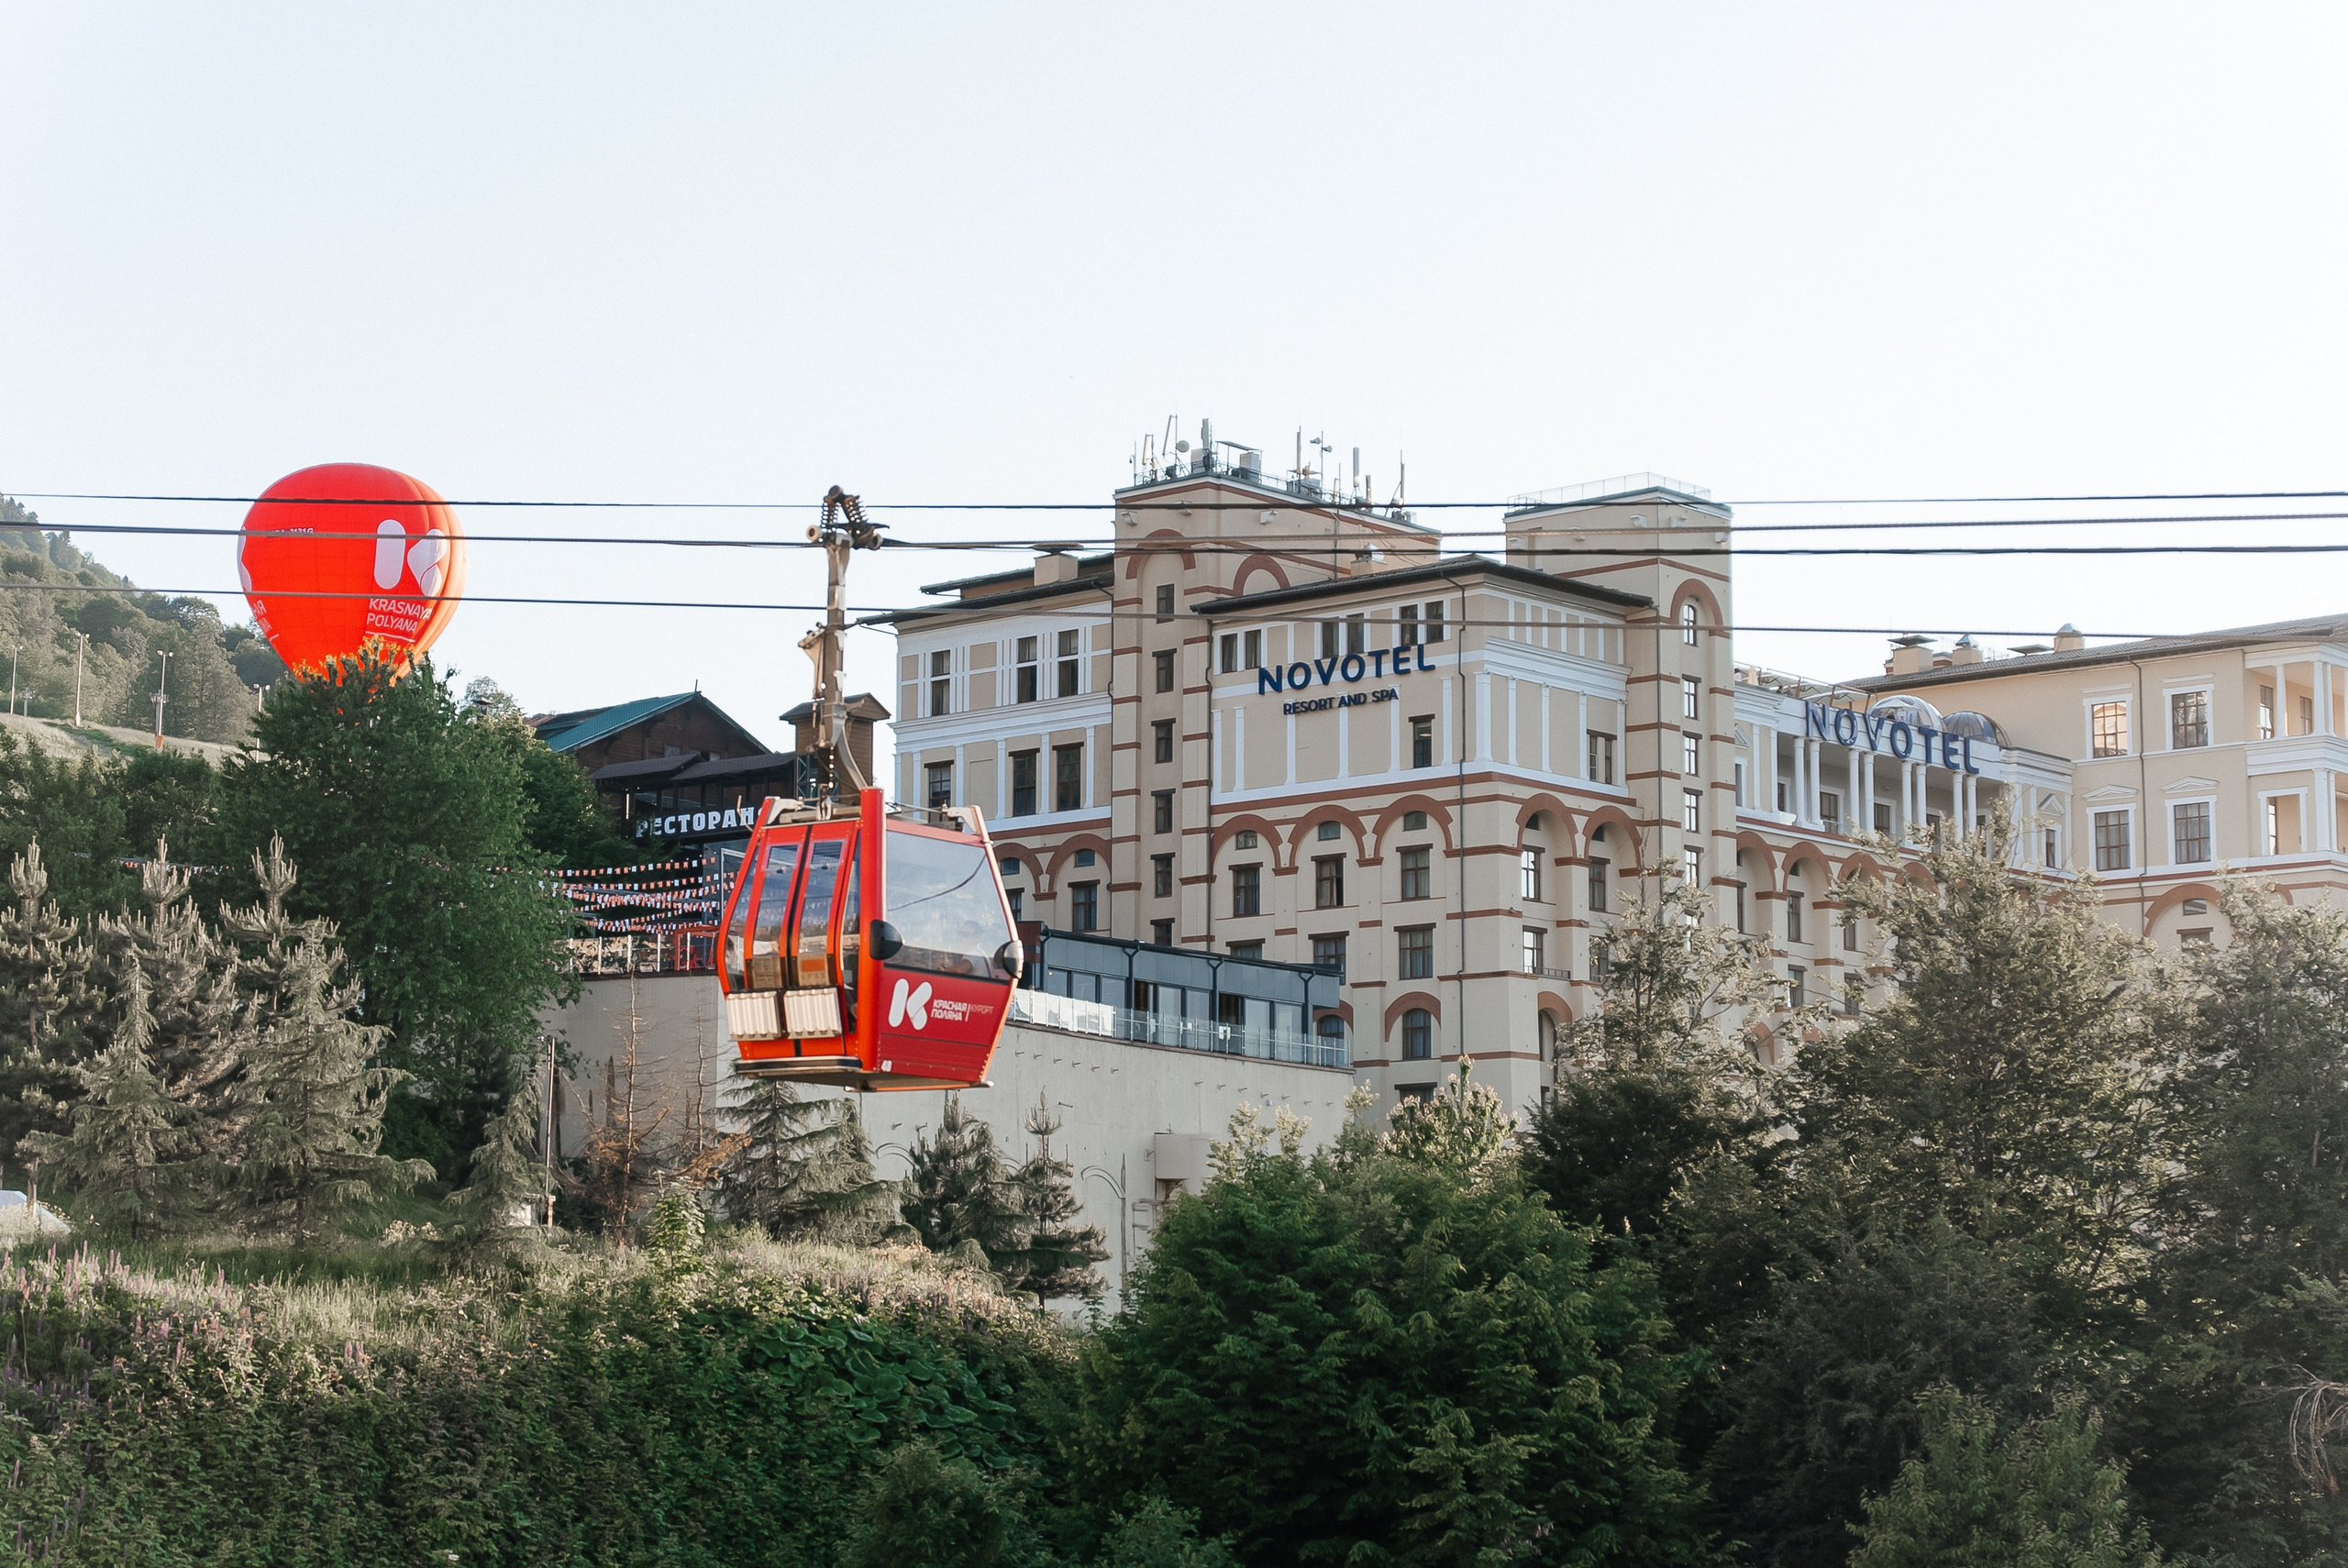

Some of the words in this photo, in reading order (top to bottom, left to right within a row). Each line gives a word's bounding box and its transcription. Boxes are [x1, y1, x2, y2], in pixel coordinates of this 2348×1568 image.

[369, 598, 433, 621] KRASNAYA
[367, 613, 418, 634] POLYANA
[1258, 644, 1436, 695] NOVOTEL
[1283, 696, 1335, 715] RESORT
[1337, 692, 1368, 708] AND
[1371, 688, 1399, 703] SPA
[1805, 701, 1979, 775] NOVOTEL
[930, 1008, 963, 1021] ПОЛЯНА
[932, 999, 968, 1012] КРАСНАЯ
